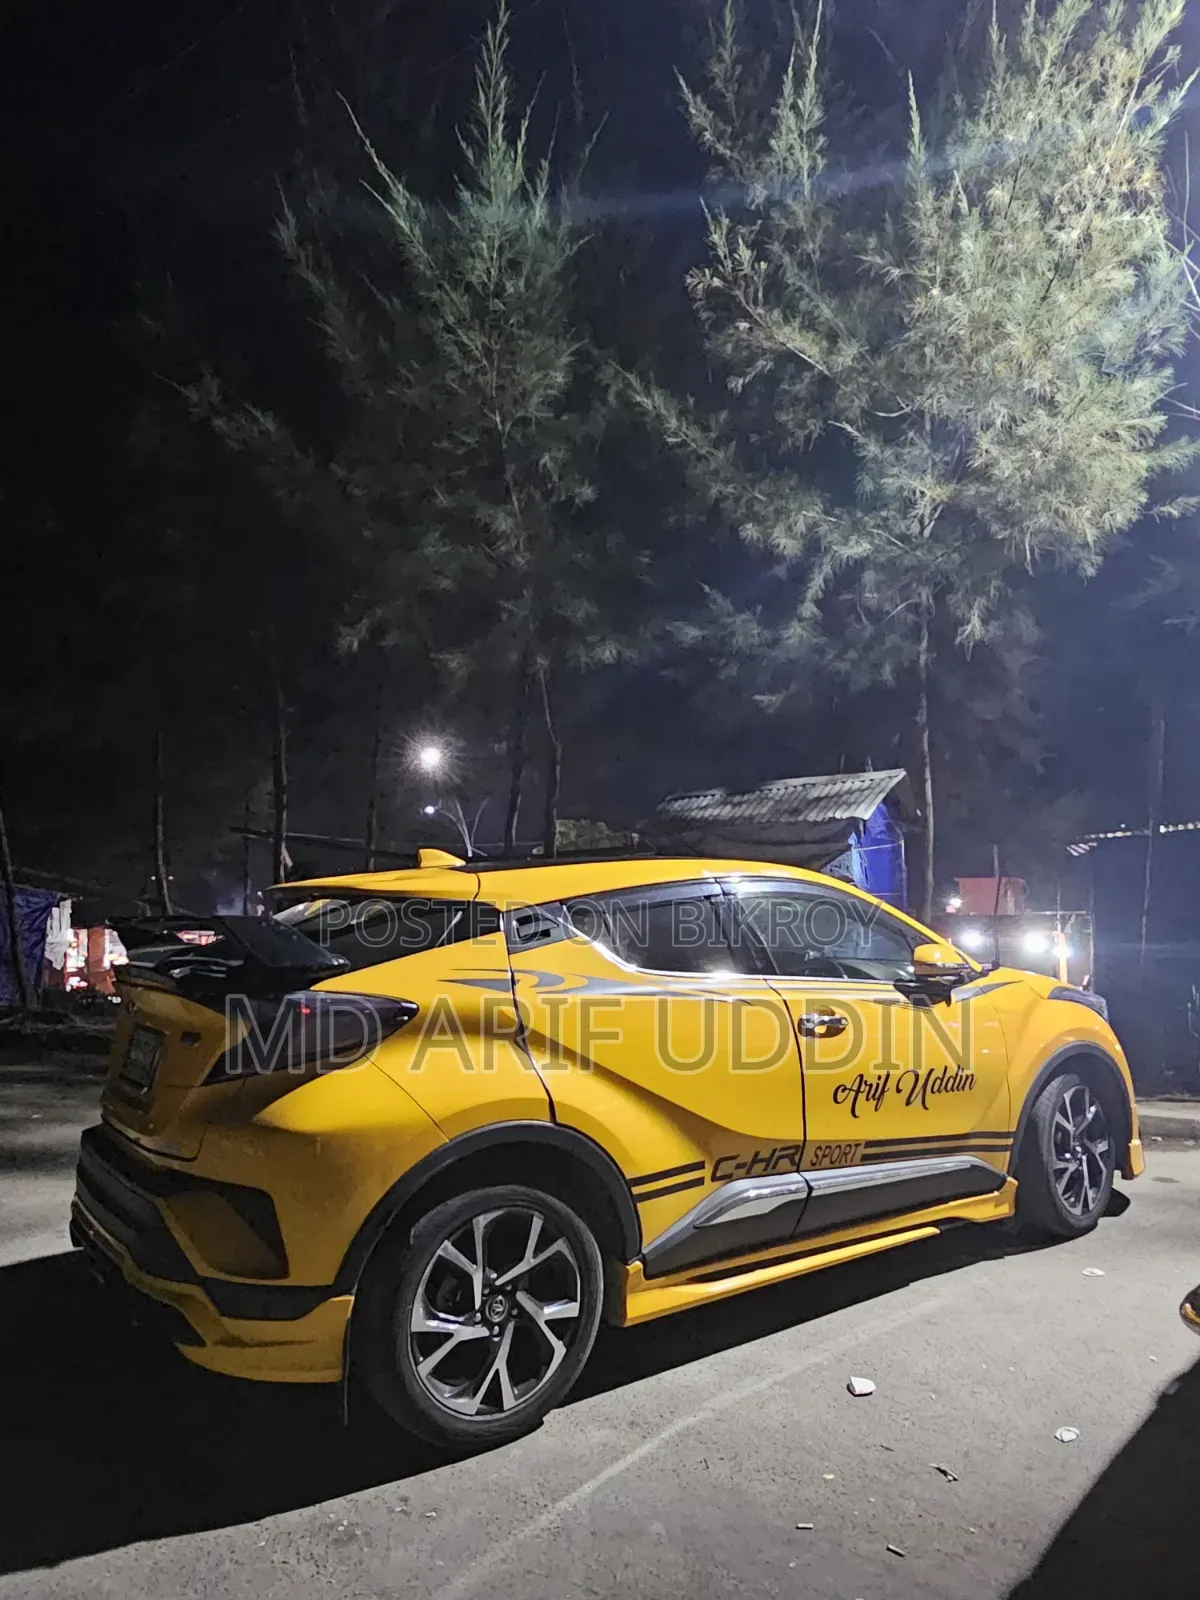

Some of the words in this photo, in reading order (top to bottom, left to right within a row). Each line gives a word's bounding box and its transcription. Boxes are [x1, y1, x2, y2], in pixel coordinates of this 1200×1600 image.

[832, 1070, 890, 1118] Arif
[895, 1064, 977, 1110] Uddin
[711, 1144, 800, 1182] C-HR
[809, 1143, 862, 1167] SPORT
